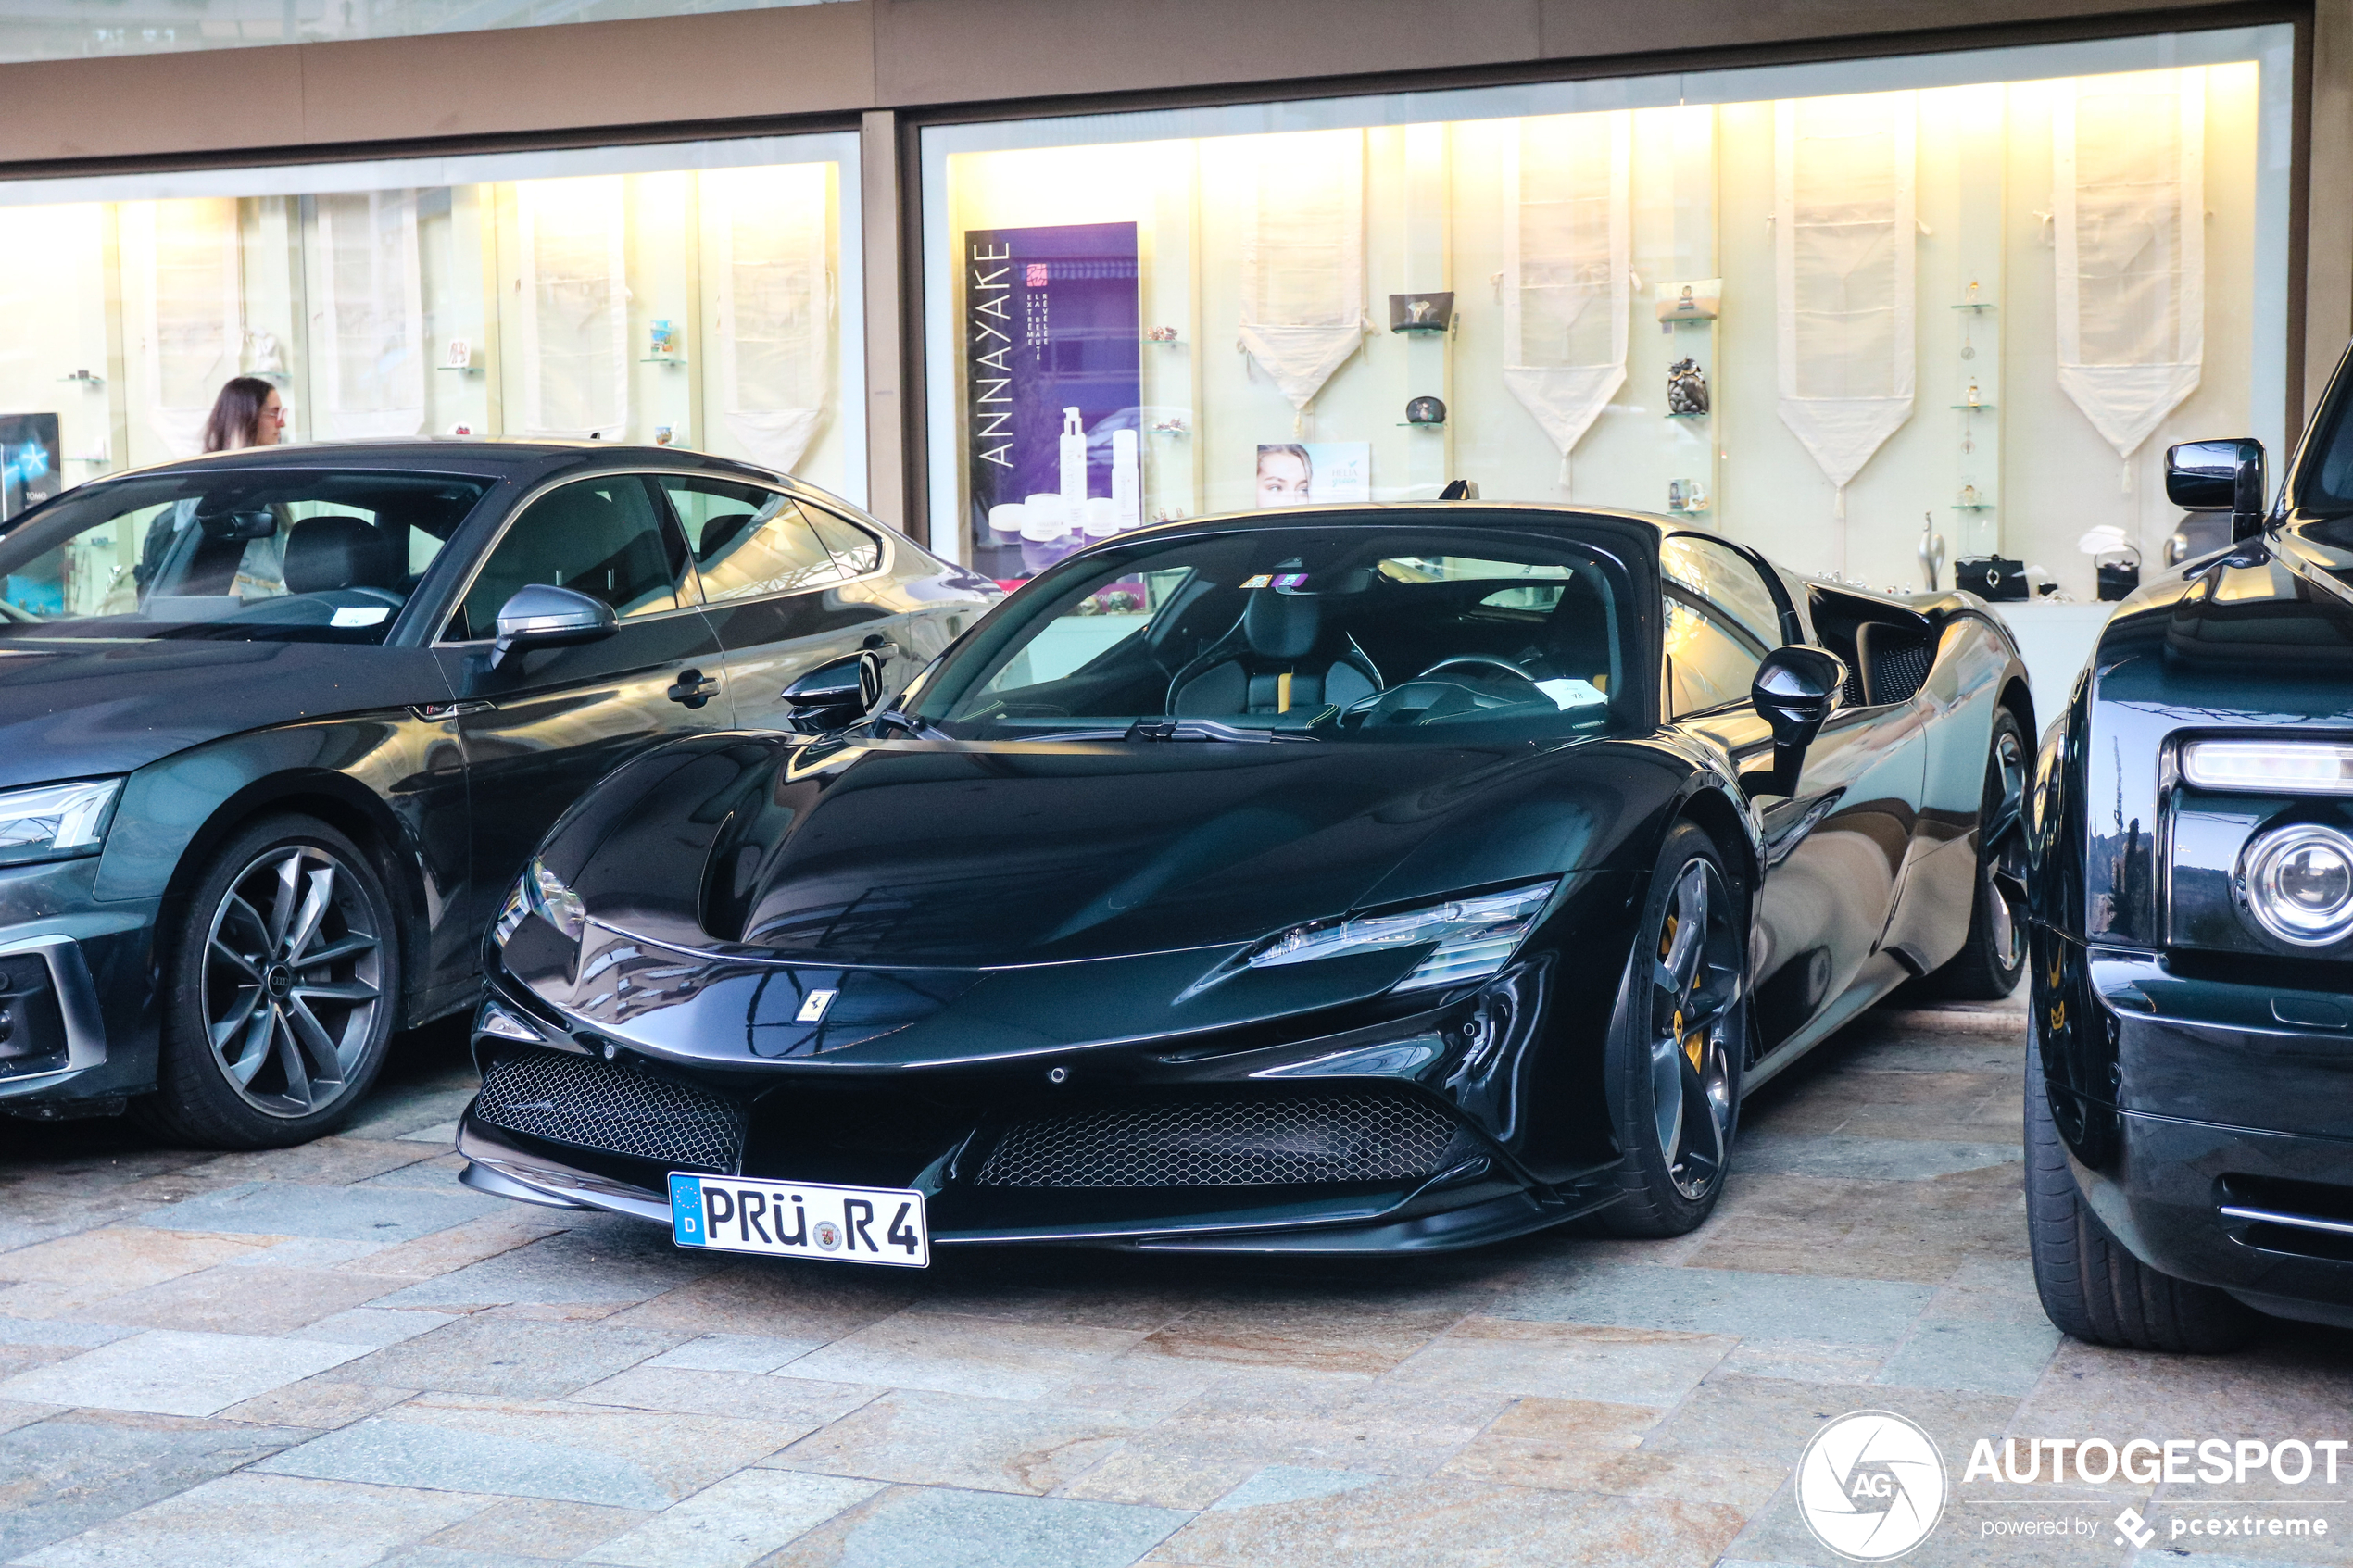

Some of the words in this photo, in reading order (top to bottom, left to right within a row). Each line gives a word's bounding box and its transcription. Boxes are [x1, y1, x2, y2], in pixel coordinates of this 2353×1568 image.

[1035, 294, 1040, 307] LA
[974, 243, 1013, 468] ANNAYAKE
[1331, 469, 1358, 477] HELIA
[1332, 478, 1357, 488] green
[26, 491, 47, 501] TOMO
[685, 1217, 696, 1233] D
